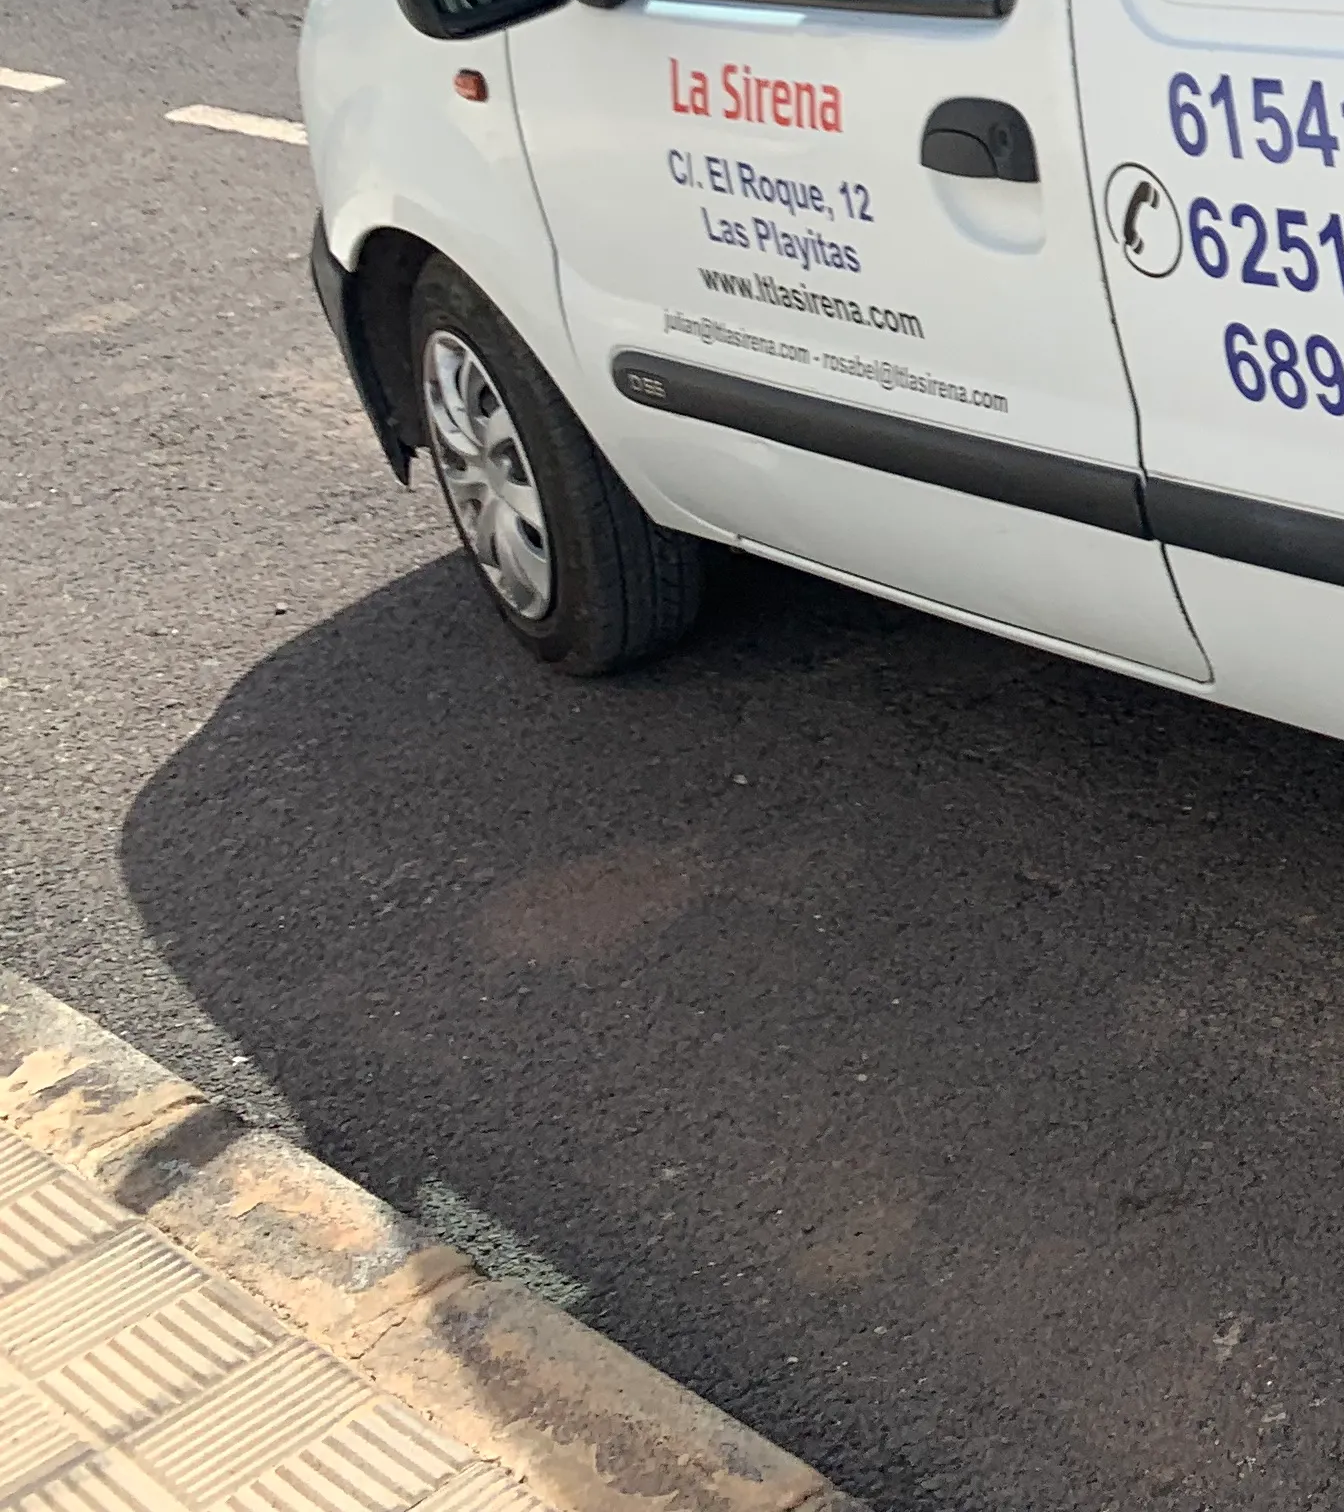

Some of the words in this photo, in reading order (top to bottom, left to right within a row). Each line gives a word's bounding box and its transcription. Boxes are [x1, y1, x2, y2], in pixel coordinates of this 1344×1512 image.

[668, 56, 712, 117] La
[721, 62, 844, 133] Sirena
[705, 155, 735, 195] El
[736, 160, 835, 221] Roque,
[839, 180, 875, 223] 12
[700, 205, 751, 249] Las
[751, 216, 862, 273] Playitas
[697, 267, 926, 339] www.ltlasirena.com
